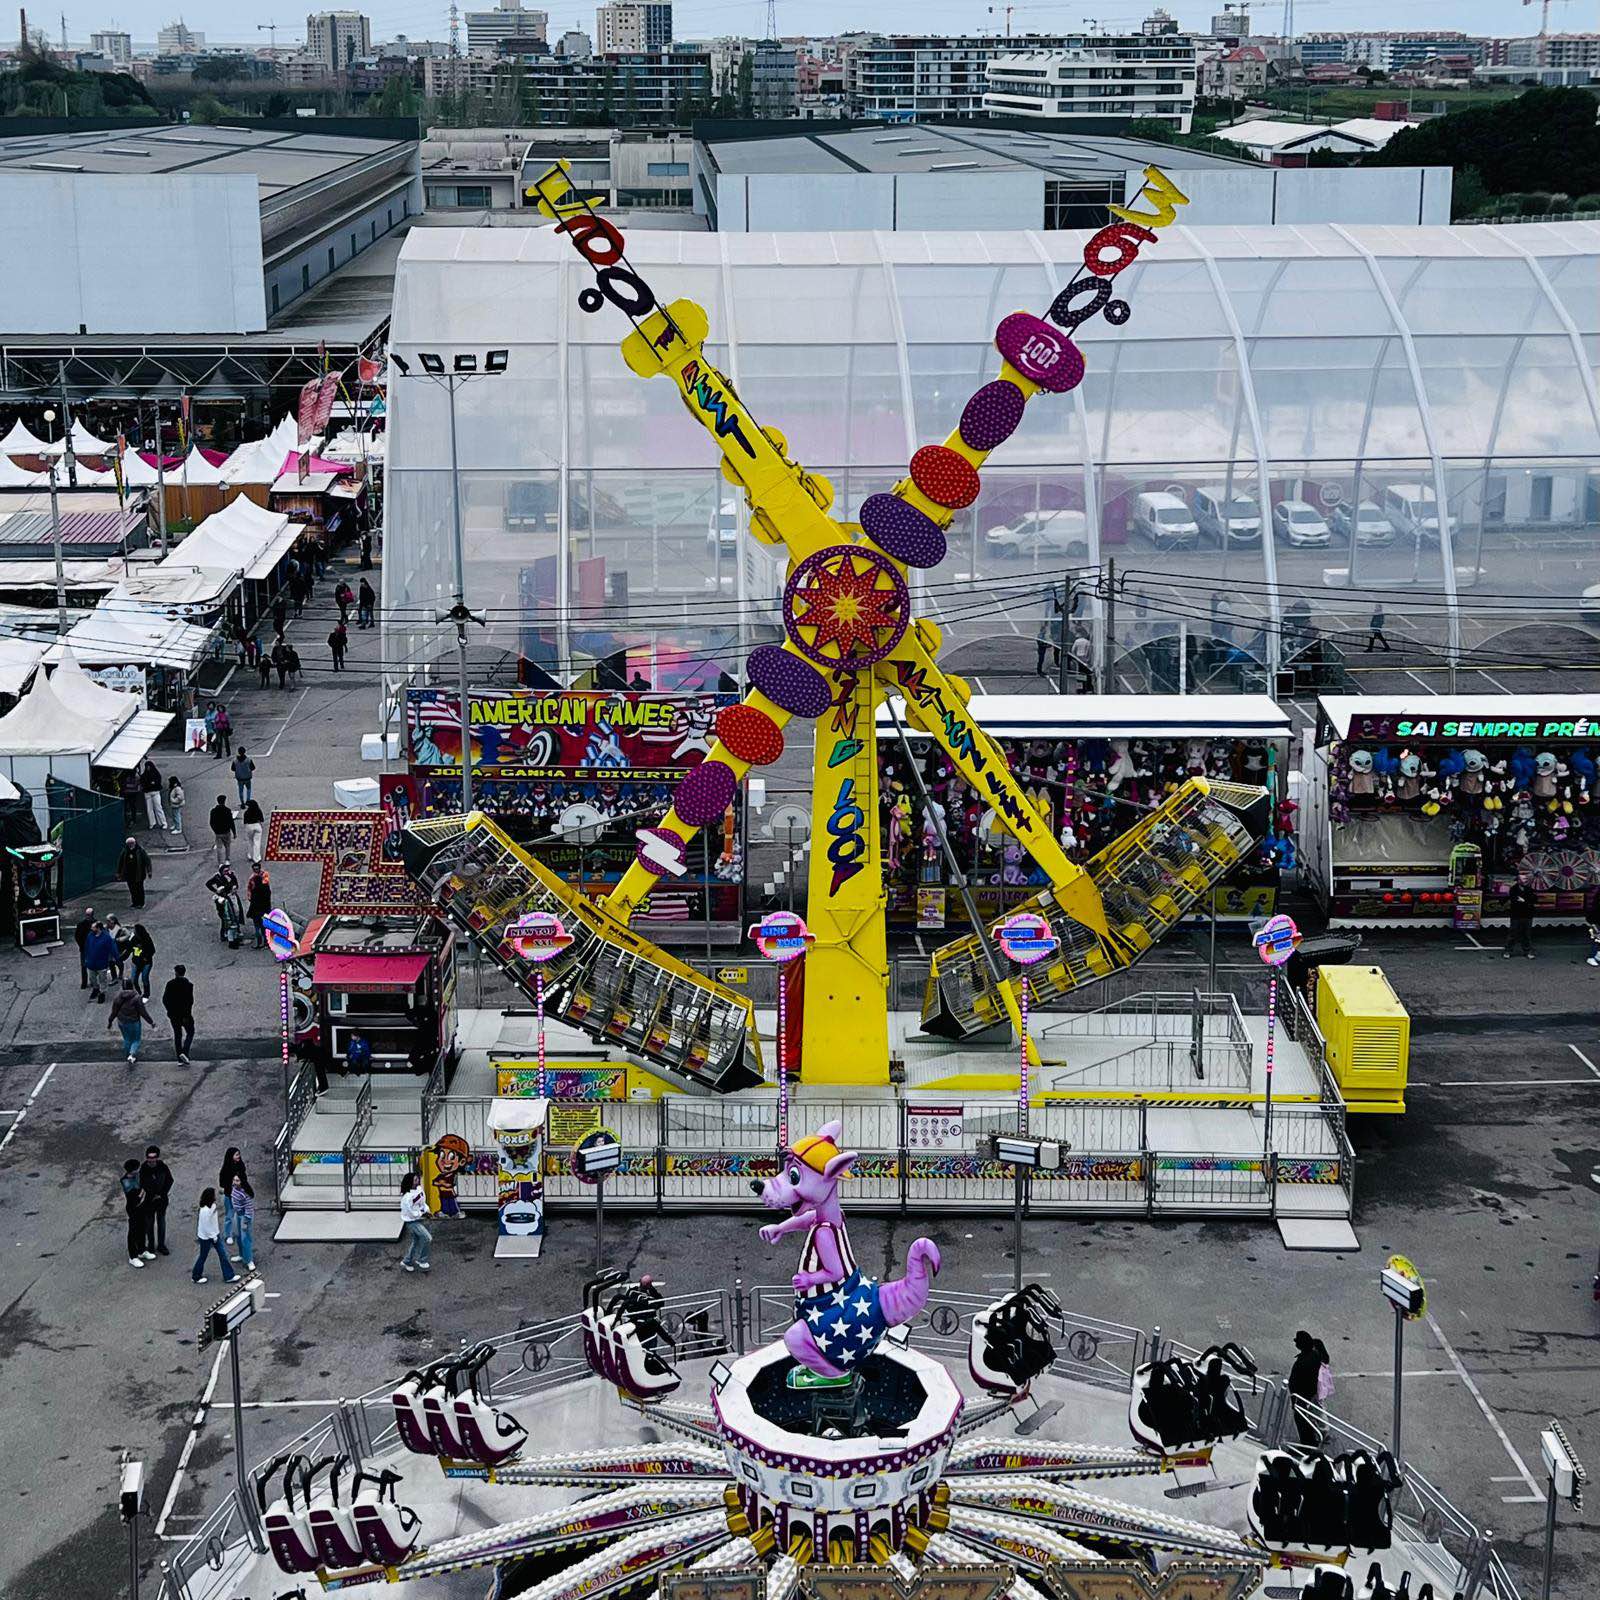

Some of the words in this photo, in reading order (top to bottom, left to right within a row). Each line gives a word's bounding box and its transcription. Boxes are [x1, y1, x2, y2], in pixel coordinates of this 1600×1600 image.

[1022, 335, 1060, 369] LOOP
[470, 698, 586, 726] AMERICAN
[595, 703, 675, 728] GAMES
[1396, 721, 1437, 738] SAI
[1442, 721, 1539, 738] SEMPRE
[500, 768, 566, 778] GANHA
[574, 769, 589, 779] E
[827, 778, 865, 898] LOOP
[510, 928, 533, 937] NEW
[534, 927, 556, 936] TOP
[760, 926, 788, 937] KING
[533, 938, 555, 947] XXL
[499, 1133, 530, 1145] BOXER
[632, 1462, 662, 1474] LOUCO
[663, 1462, 689, 1473] XXL
[979, 1456, 1001, 1468] XXL
[1046, 1457, 1072, 1467] LOUCO
[624, 1503, 659, 1520] XXL
[1052, 1505, 1105, 1525] KANGURU
[583, 1565, 623, 1593] LOUCO
